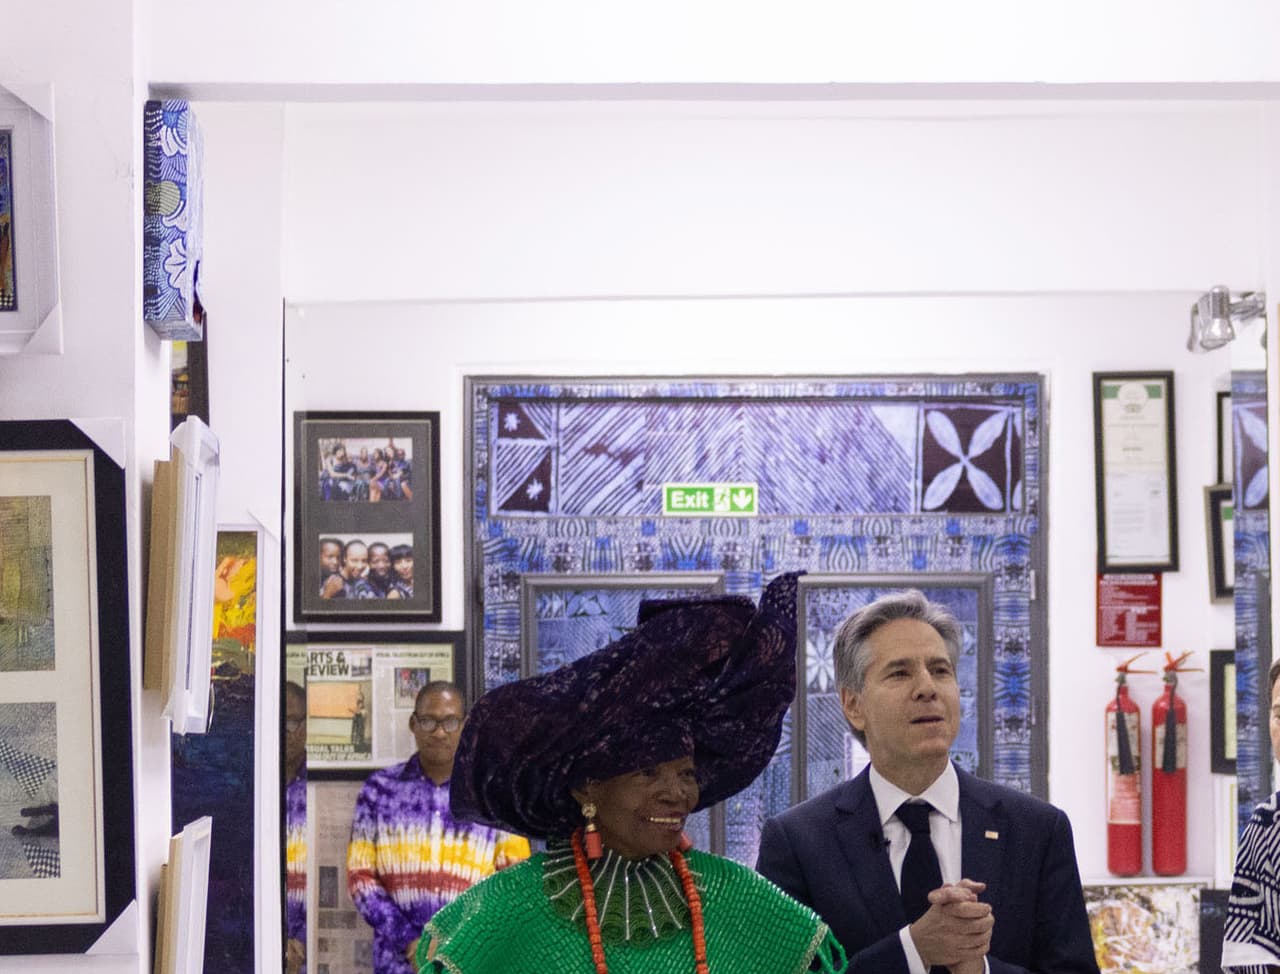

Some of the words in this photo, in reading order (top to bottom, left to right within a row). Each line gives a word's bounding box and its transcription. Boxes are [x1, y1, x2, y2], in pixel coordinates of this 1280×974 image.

[671, 490, 708, 509] Exit
[306, 651, 333, 664] RTS
[336, 651, 346, 664] &
[306, 663, 350, 676] EVIEW
